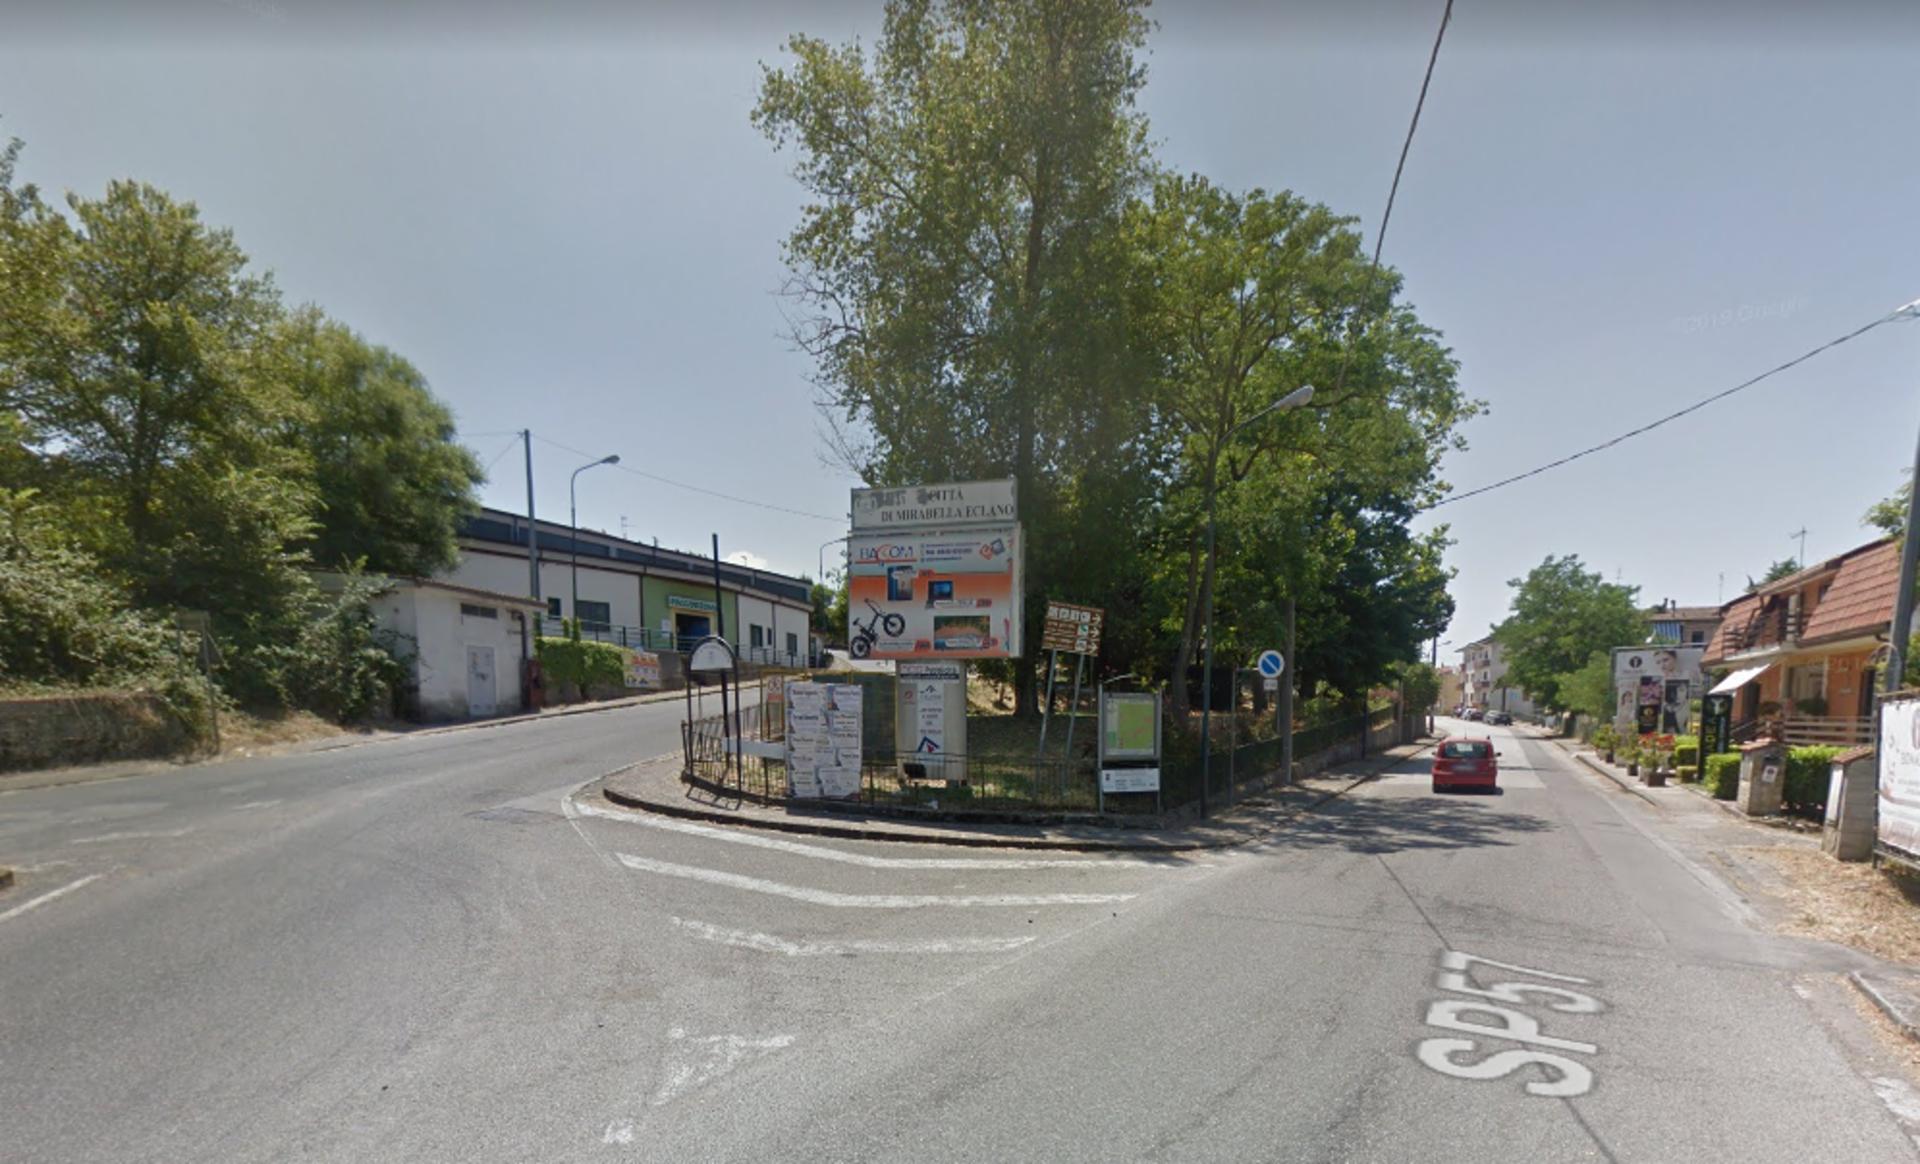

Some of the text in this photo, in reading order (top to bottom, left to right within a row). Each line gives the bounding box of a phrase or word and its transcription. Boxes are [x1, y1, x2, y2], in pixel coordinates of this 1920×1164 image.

[881, 503, 1014, 523] DI MIRABELLA ECLANO
